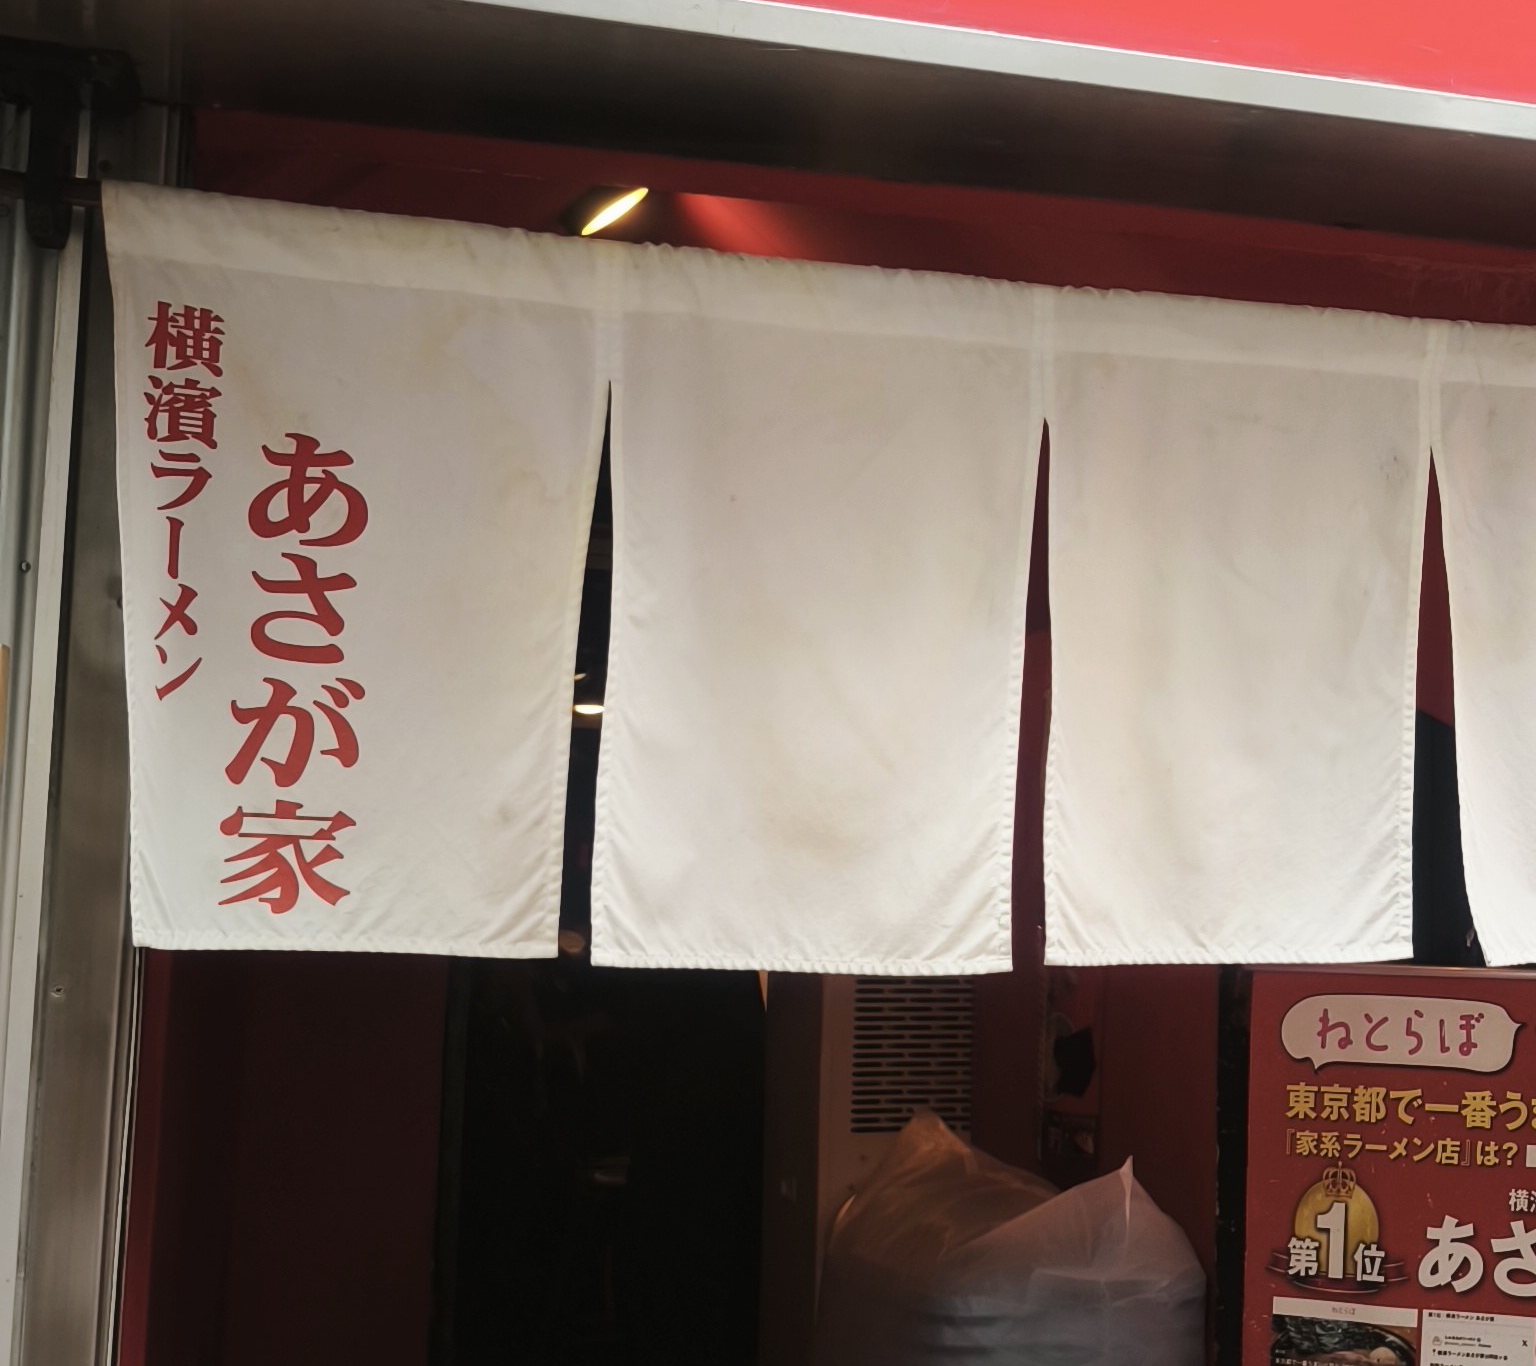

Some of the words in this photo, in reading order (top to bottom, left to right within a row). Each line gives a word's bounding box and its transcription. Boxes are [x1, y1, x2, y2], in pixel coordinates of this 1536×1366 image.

[143, 300, 226, 701] 横濱ラーメン
[218, 432, 369, 914] あさが家
[1317, 1007, 1486, 1058] ねとらぼ
[1287, 1201, 1386, 1284] 第1位
